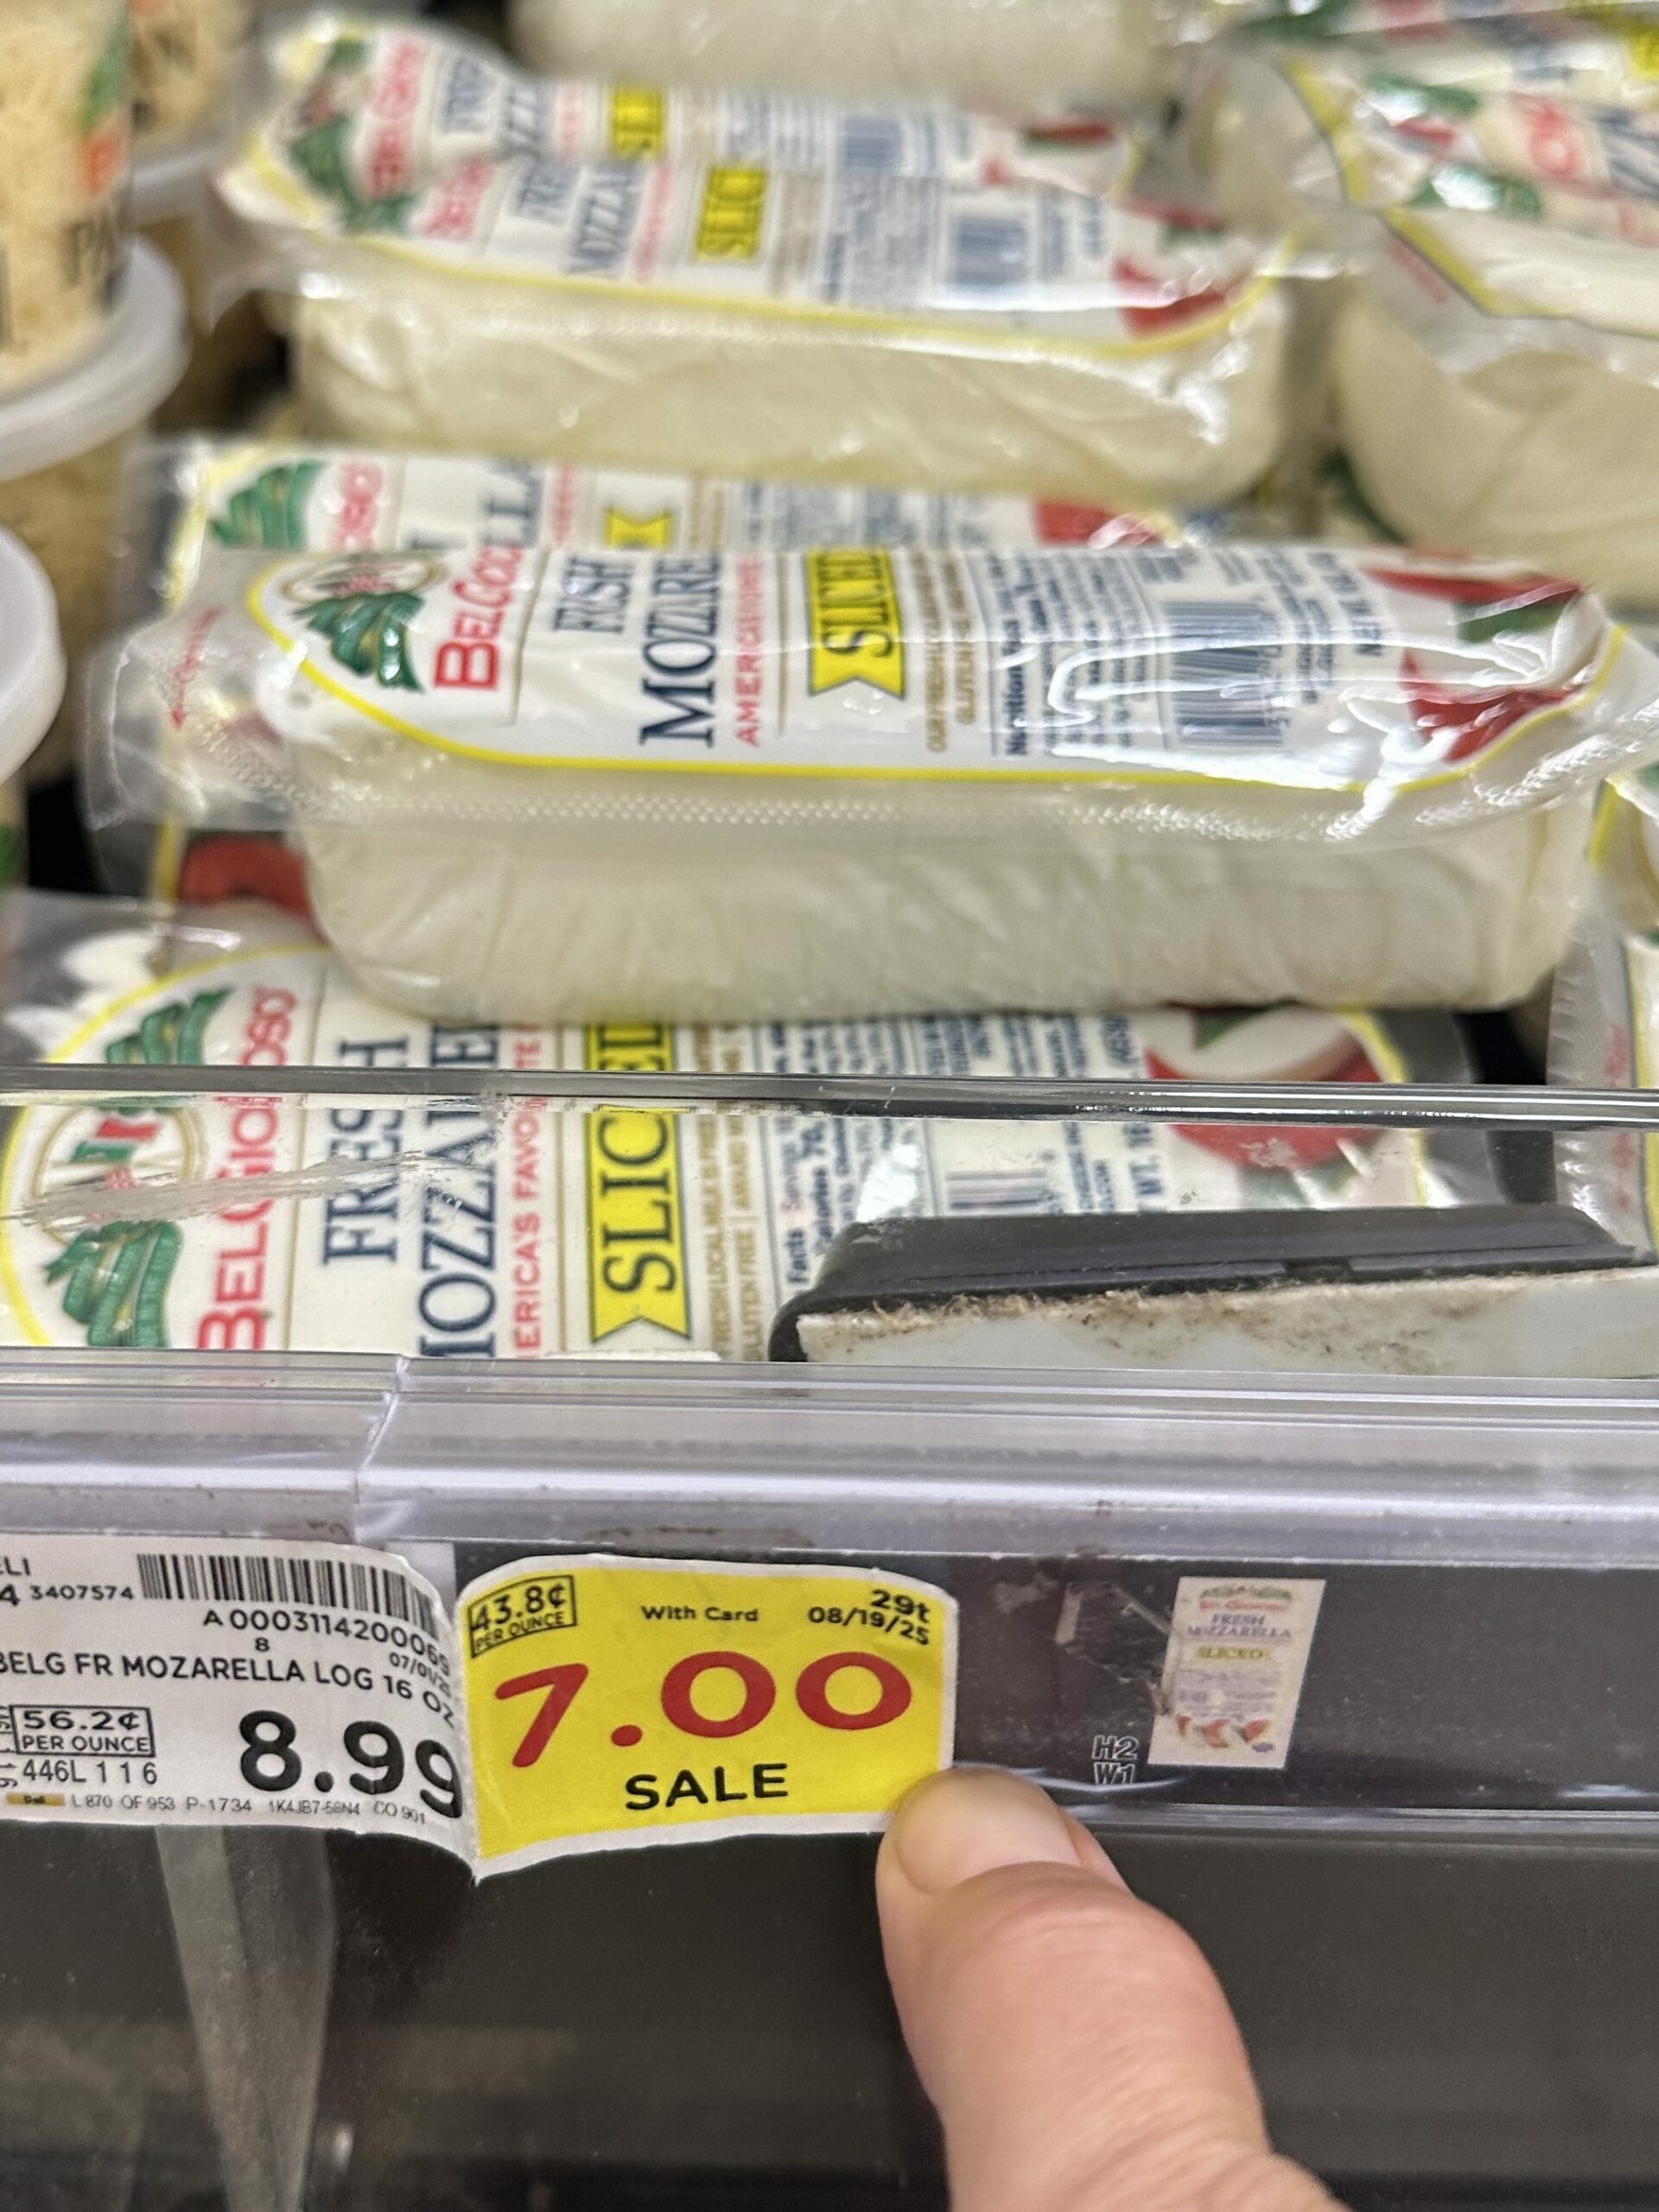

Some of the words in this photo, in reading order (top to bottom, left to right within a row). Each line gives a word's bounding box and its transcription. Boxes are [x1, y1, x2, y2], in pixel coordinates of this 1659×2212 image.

[512, 1213, 542, 1358] ERICA'S
[0, 1557, 30, 1576] LI
[30, 1586, 134, 1599] 3407574
[640, 1605, 696, 1620] With
[704, 1606, 759, 1622] Card
[870, 1589, 930, 1624] 29t
[509, 1611, 564, 1637] OUNCE
[807, 1606, 930, 1646] 08/19/25
[255, 1637, 270, 1652] 8
[74, 1653, 112, 1675] FR
[122, 1655, 304, 1681] MOZARELLA
[315, 1662, 373, 1690] LOG
[383, 1675, 412, 1700] 16
[423, 1691, 454, 1729] OZ
[23, 1710, 140, 1730] 56.2¢
[494, 1650, 912, 1768] 7.00
[22, 1734, 64, 1750] PER
[72, 1736, 150, 1752] OUNCE
[1091, 1735, 1139, 1759] H2
[239, 1710, 463, 1819] 8.99
[1093, 1762, 1135, 1784] W1
[626, 1763, 788, 1811] SALE
[121, 1795, 143, 1809] OF
[186, 1797, 252, 1812] P-1734
